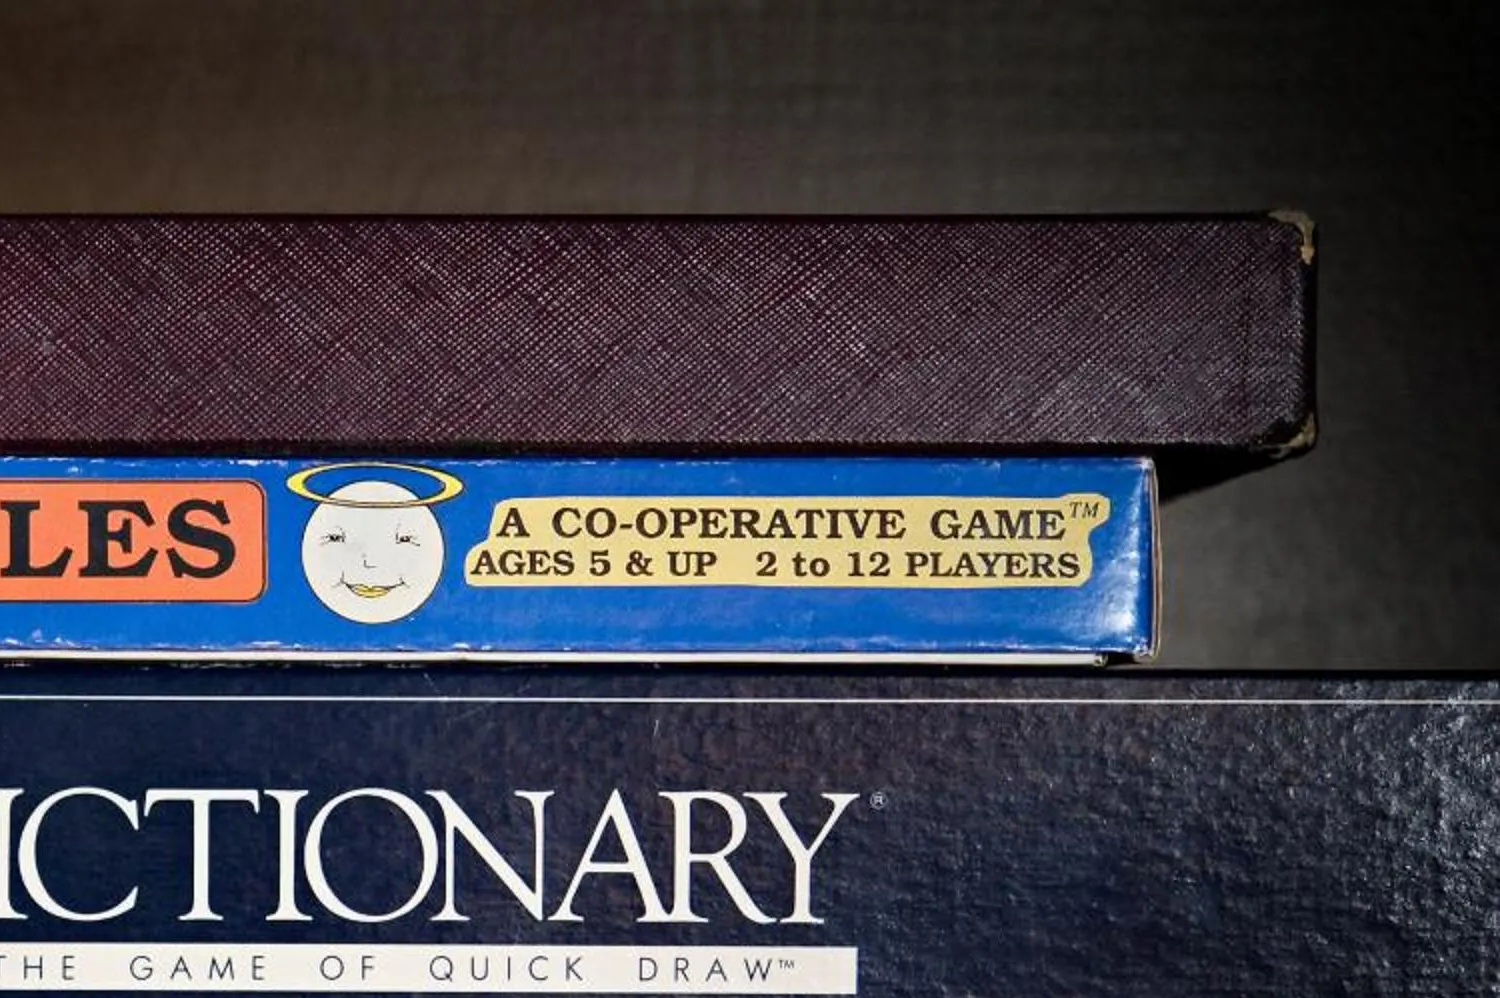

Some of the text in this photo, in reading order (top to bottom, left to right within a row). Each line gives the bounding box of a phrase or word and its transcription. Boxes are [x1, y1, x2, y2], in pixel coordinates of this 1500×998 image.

[496, 508, 530, 539] A
[551, 508, 904, 540] CO-OPERATIVE
[470, 552, 1080, 578] AGES 5 & UP 2 to 12 PLAYERS
[129, 956, 267, 981] GAME
[320, 956, 375, 981] OF
[429, 956, 585, 984] QUICK
